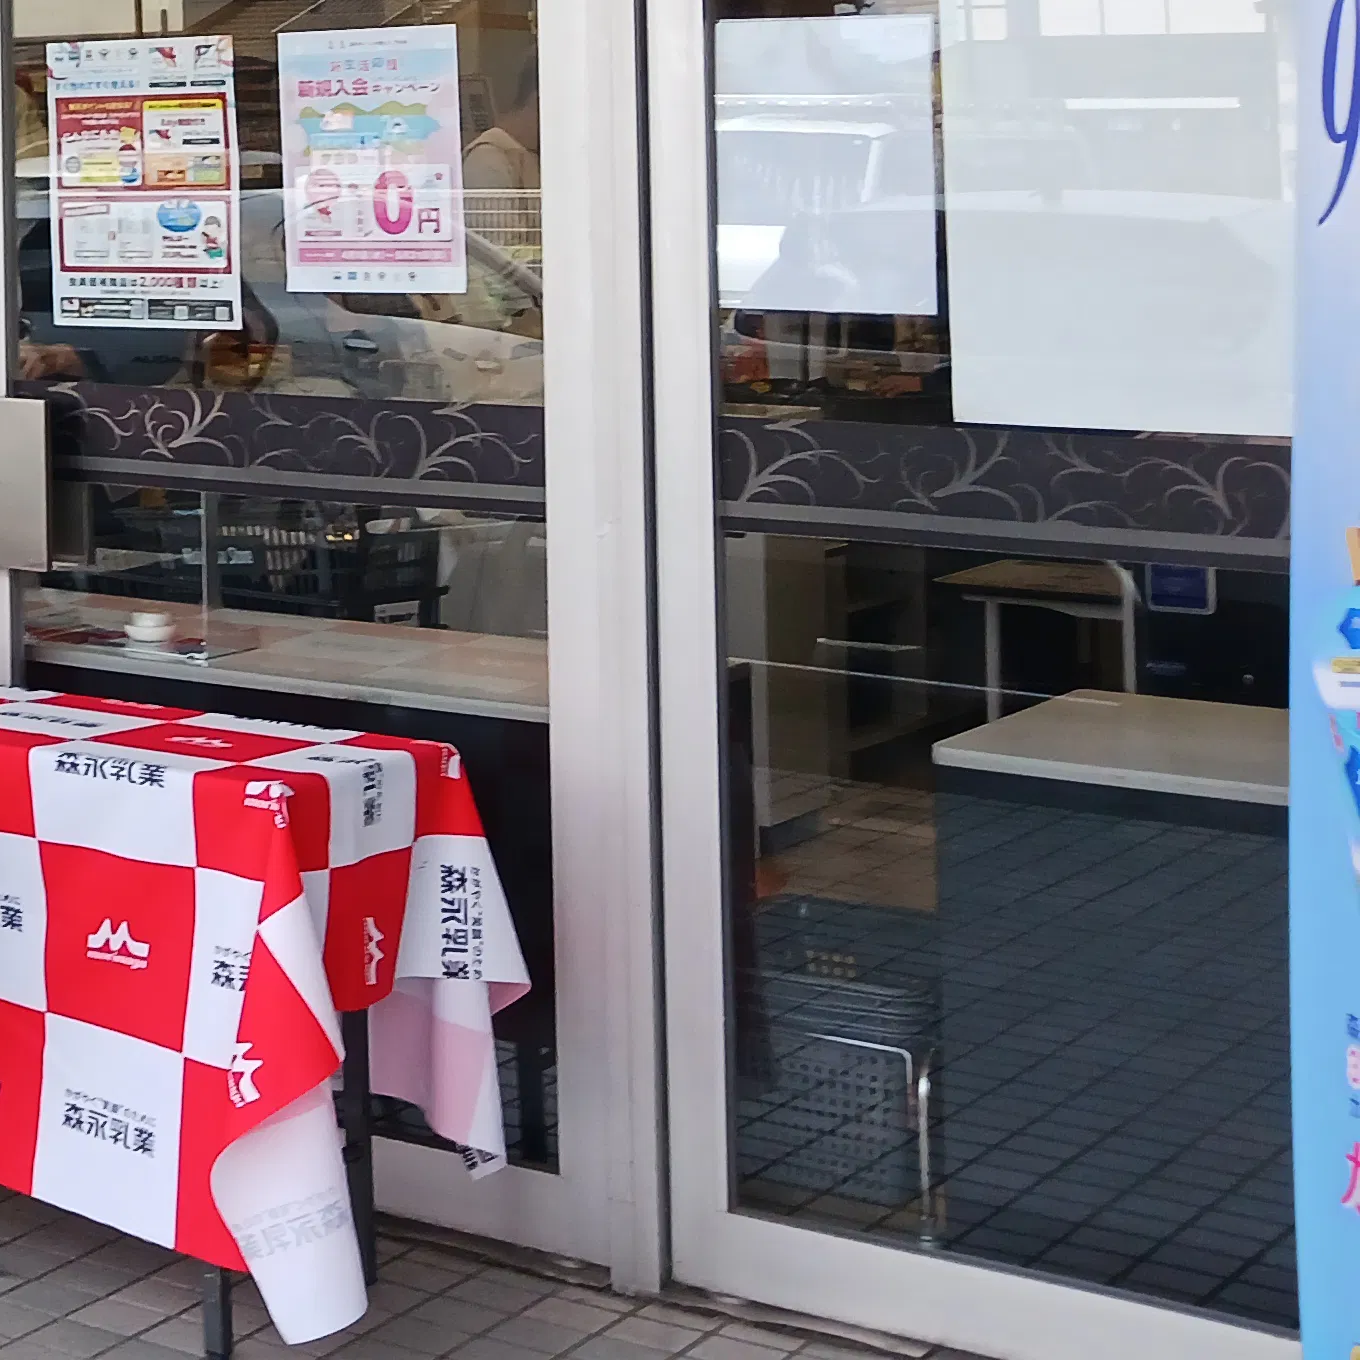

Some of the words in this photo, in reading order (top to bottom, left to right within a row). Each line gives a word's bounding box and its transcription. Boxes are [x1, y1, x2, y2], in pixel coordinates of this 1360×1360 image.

[297, 77, 442, 98] 新規入会キャンペーン
[372, 169, 441, 235] 0円
[54, 752, 168, 789] 森永乳業
[61, 1101, 156, 1159] 森永乳業
